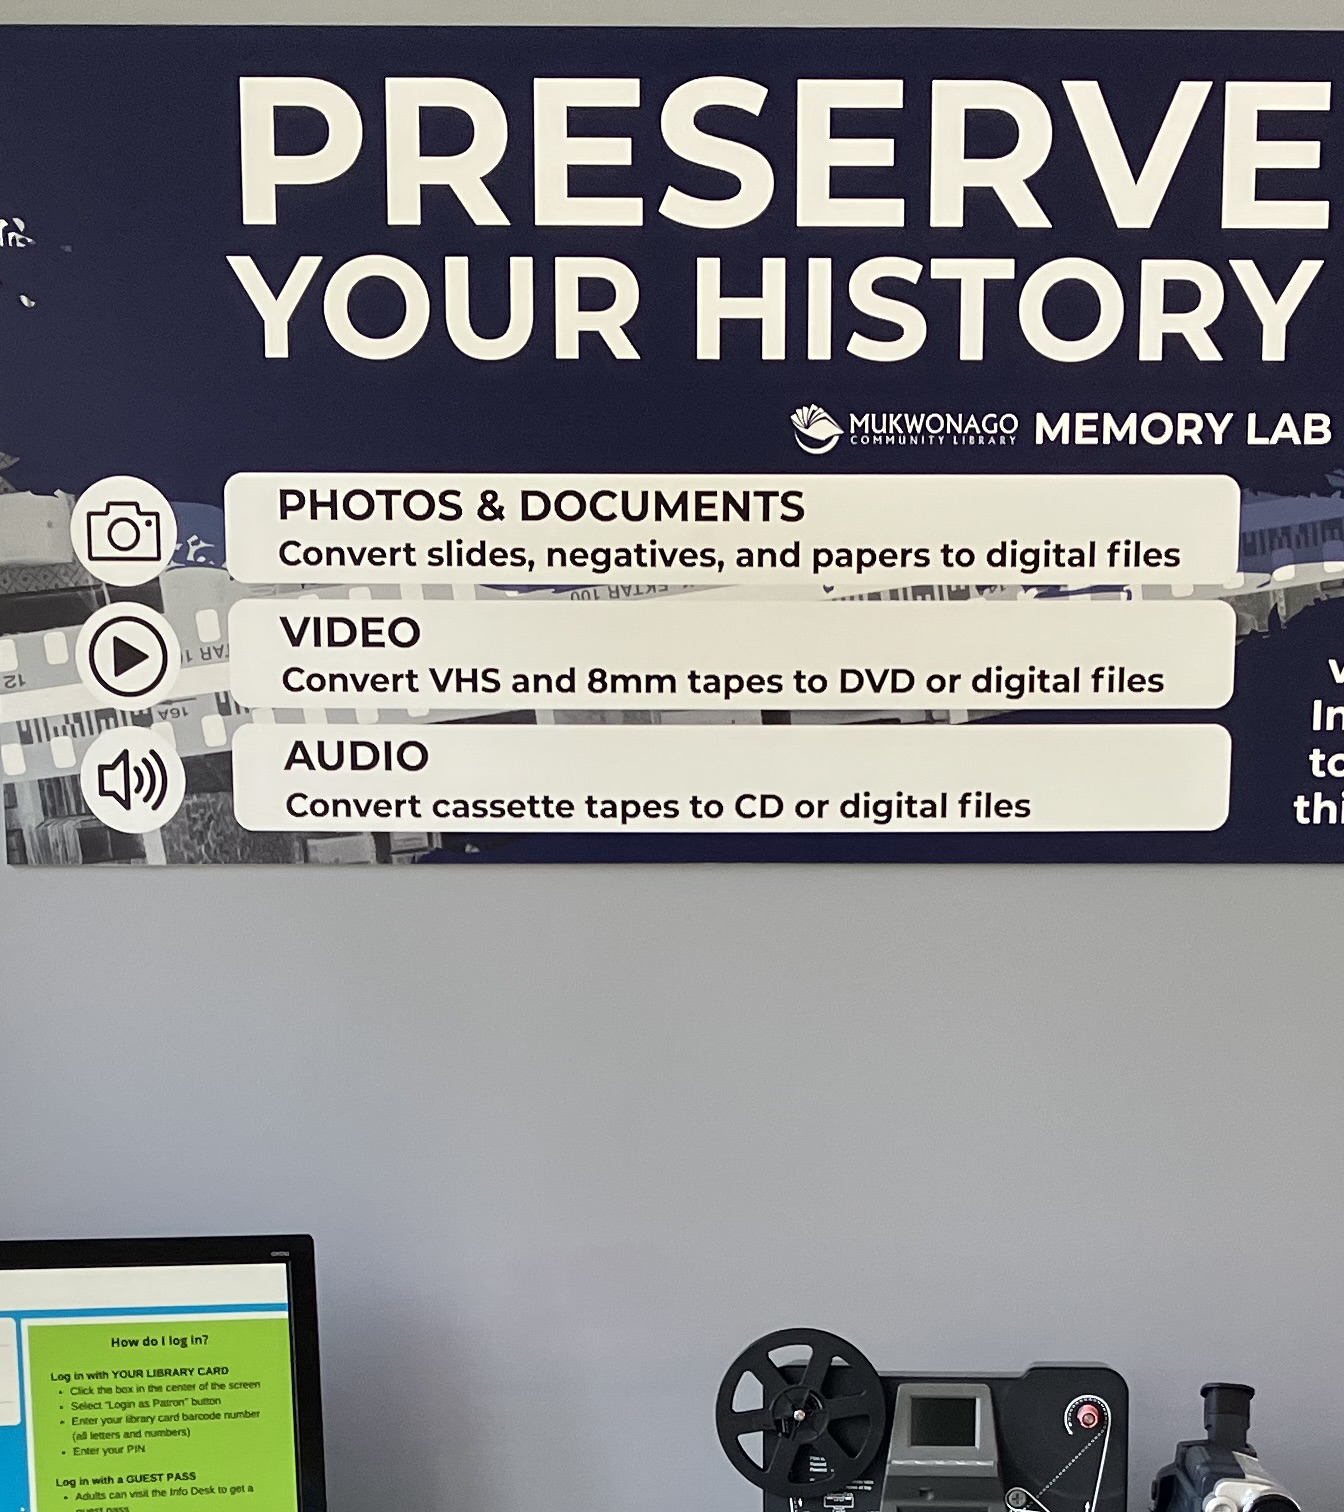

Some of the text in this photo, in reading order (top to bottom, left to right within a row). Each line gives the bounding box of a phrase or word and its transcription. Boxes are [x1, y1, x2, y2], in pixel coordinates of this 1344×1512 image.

[239, 75, 1332, 230] PRESERVE
[225, 254, 1325, 363] YOUR HISTORY
[849, 412, 1019, 435] MUKWONAGO
[1035, 411, 1332, 445] MEMORY LAB
[850, 435, 1016, 445] COMMUNITY LIBRARY
[279, 488, 805, 523] PHOTOS & DOCUMENTS
[279, 538, 1181, 575] Convert slides, negatives, and papers to digital files
[279, 616, 421, 649] VIDEO
[3, 674, 27, 688] 12
[282, 665, 1165, 701] Convert VHS and 8mm tapes to DVD or digital files
[158, 707, 189, 720] 16A
[283, 740, 429, 772] AUDIO
[286, 790, 1031, 825] Convert cassette tapes to CD or digital files
[111, 1334, 209, 1349] How do I log in?
[50, 1366, 230, 1384] Log in with YOUR LIBRARY CARD
[72, 1444, 146, 1457] Enter your PIN
[55, 1471, 197, 1489] Log in with a GUEST PASS
